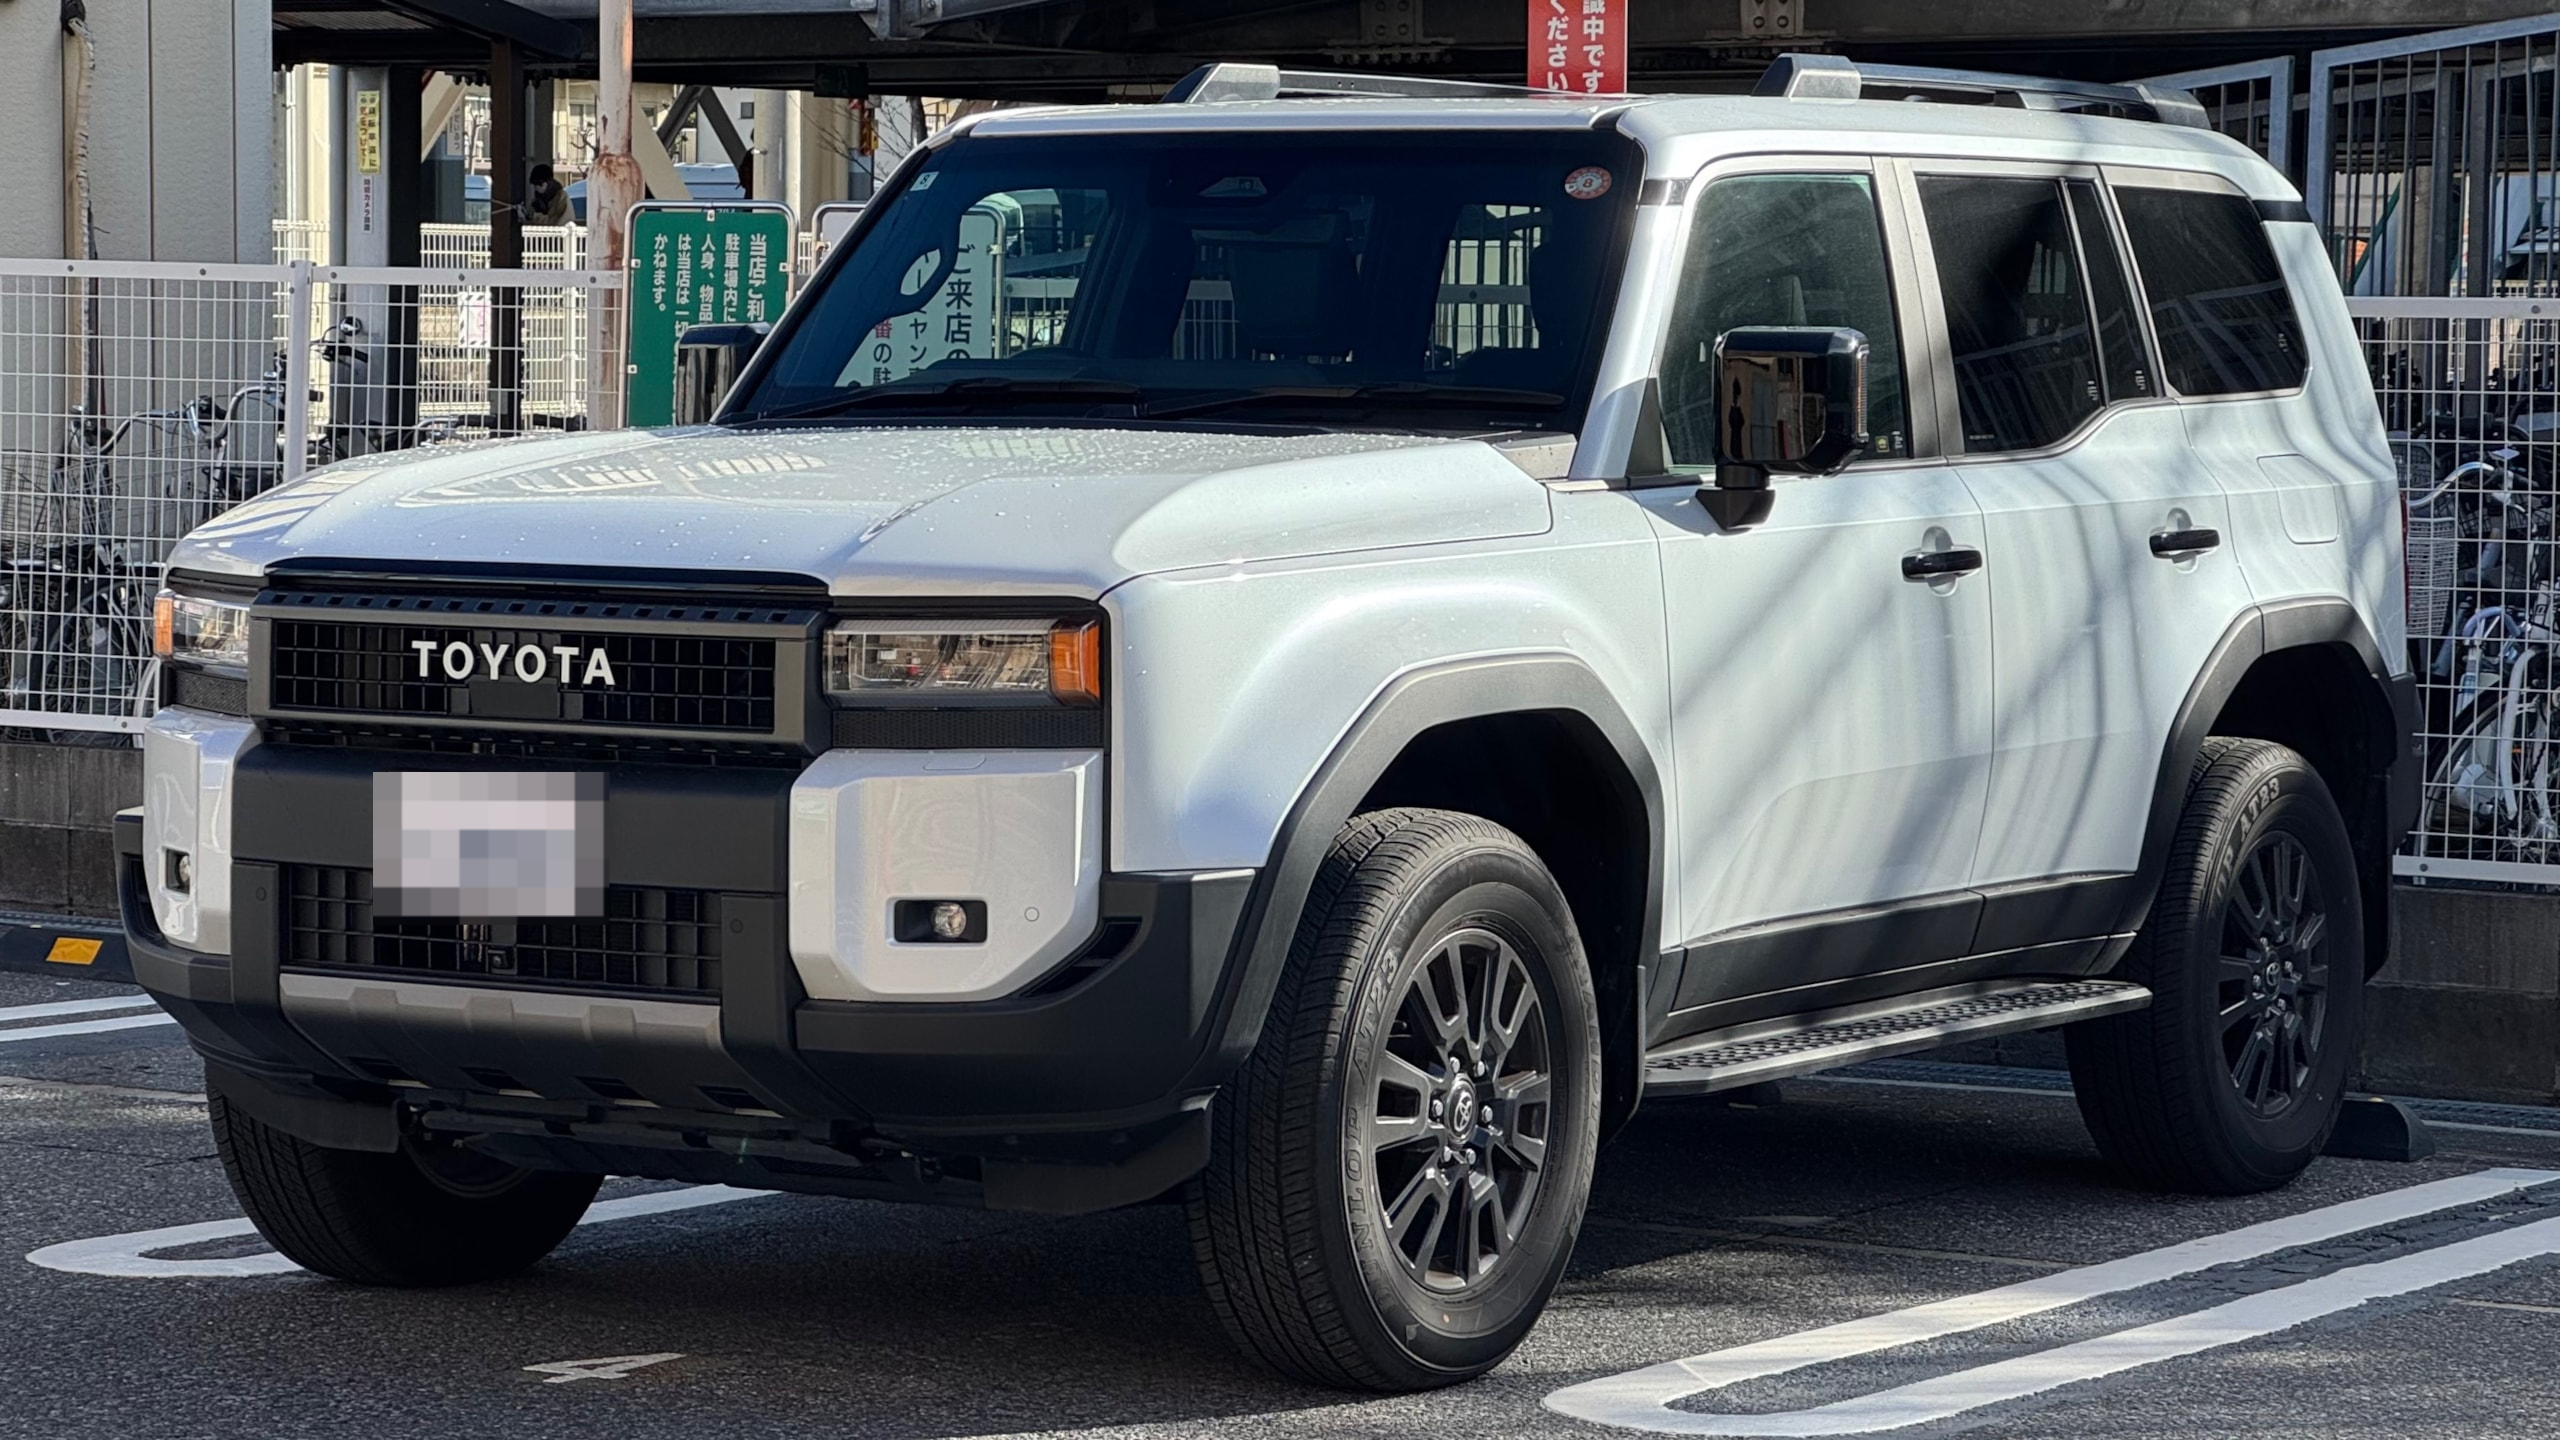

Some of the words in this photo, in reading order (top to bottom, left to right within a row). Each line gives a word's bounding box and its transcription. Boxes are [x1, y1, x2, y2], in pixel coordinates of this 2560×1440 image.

[652, 233, 669, 311] かねます。
[699, 233, 716, 324] 人身、物品
[723, 233, 740, 322] 駐車場内に
[411, 640, 616, 686] TOYOTA
[1344, 1106, 1398, 1314] DUNLOP
